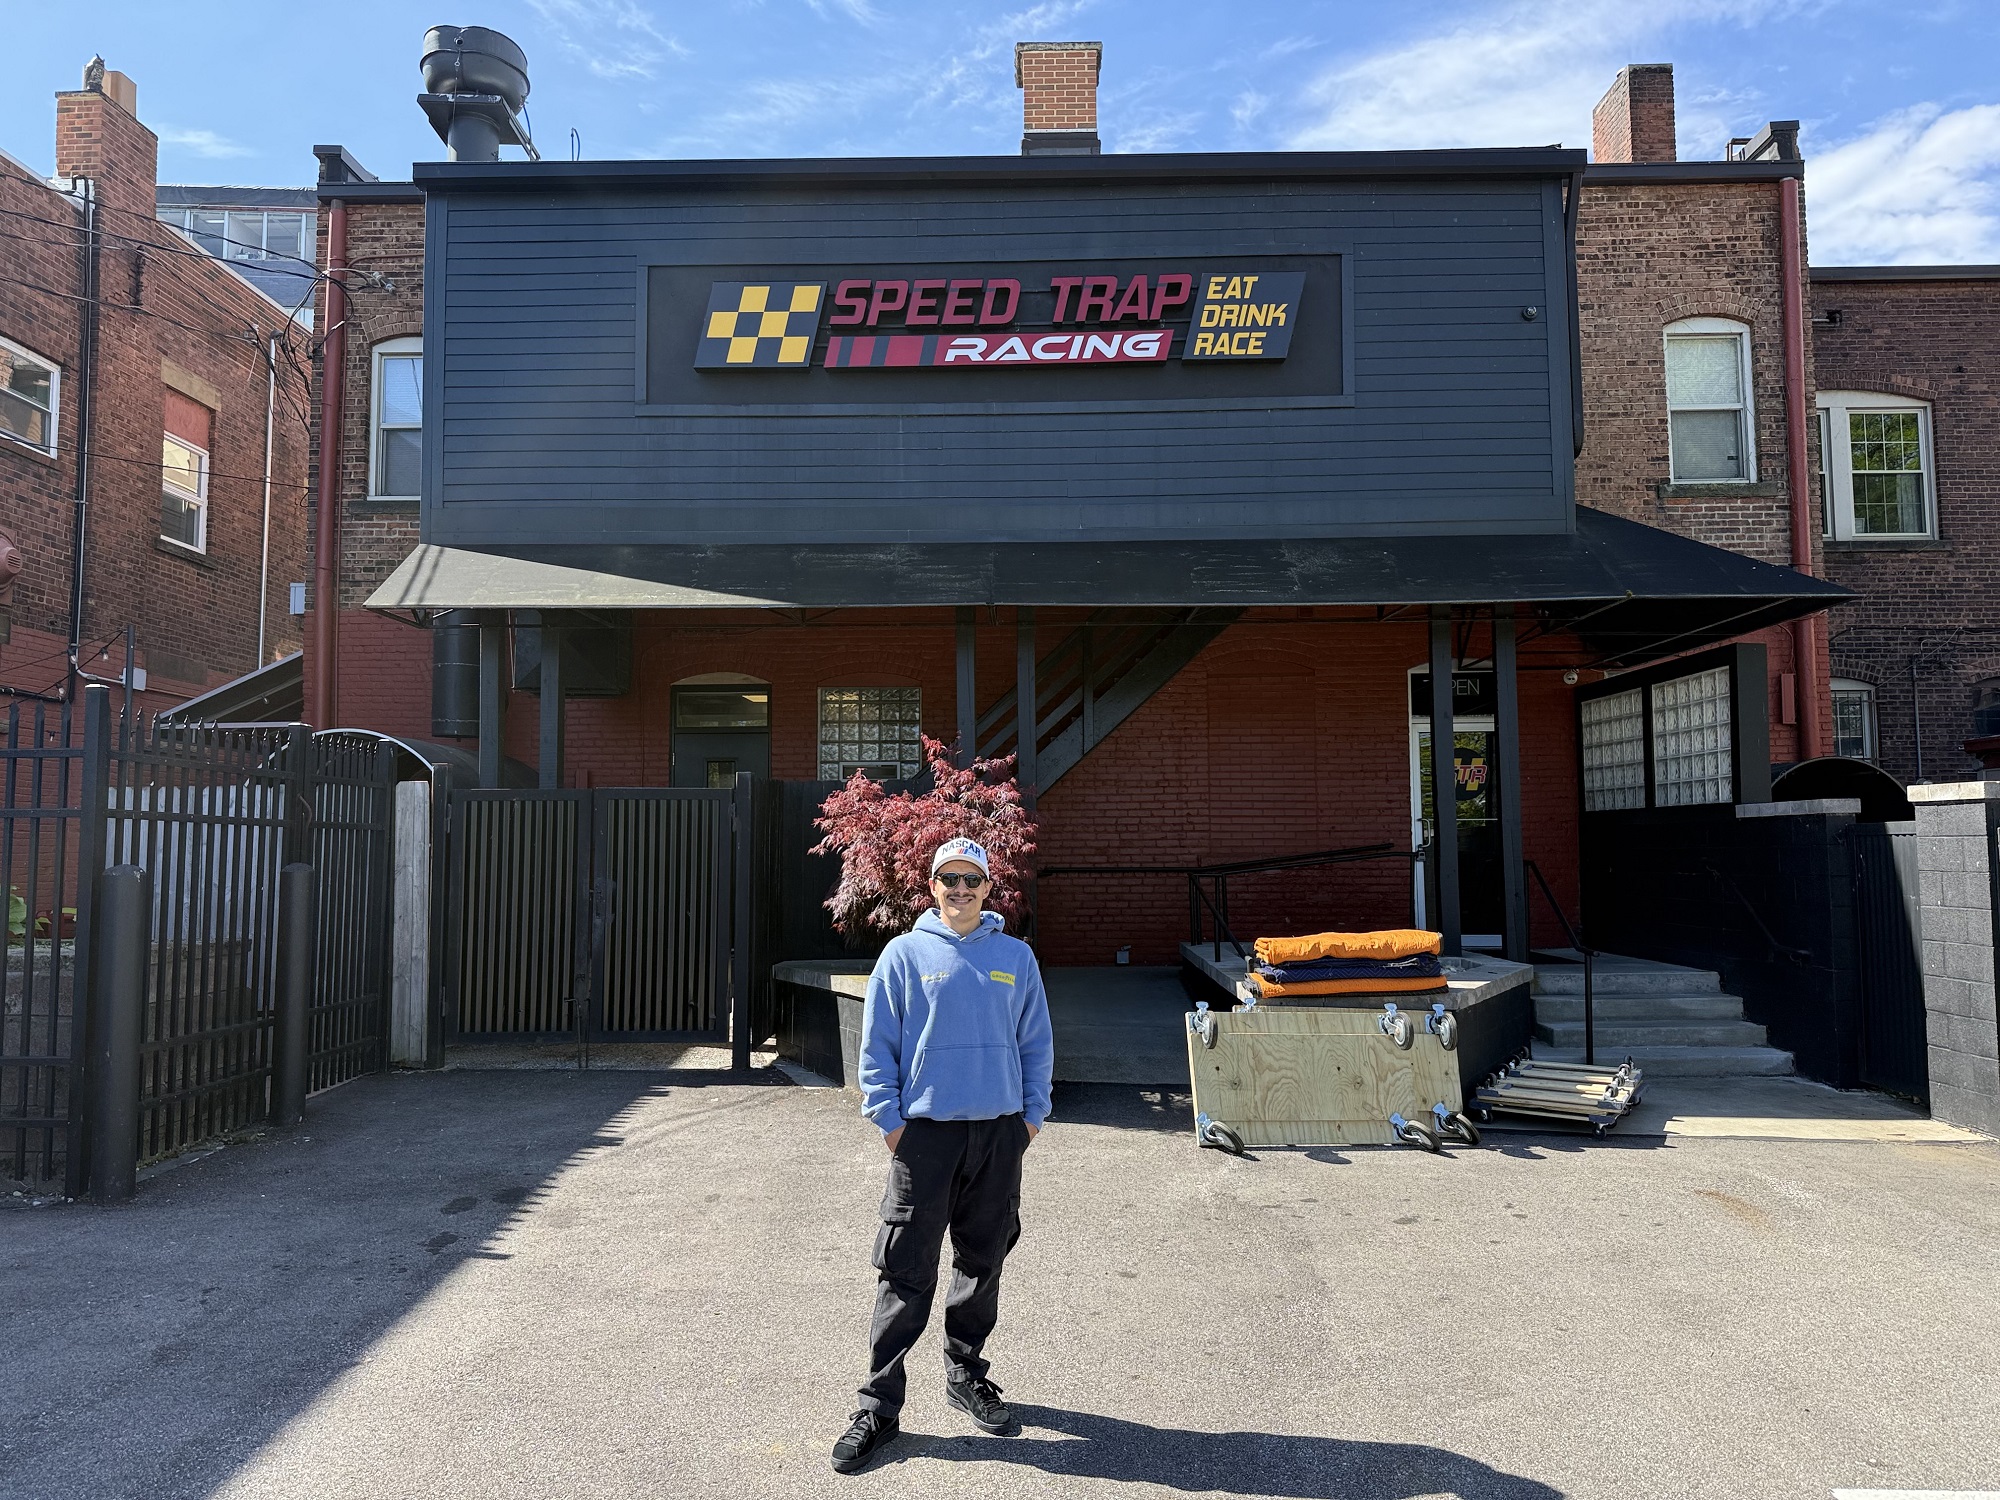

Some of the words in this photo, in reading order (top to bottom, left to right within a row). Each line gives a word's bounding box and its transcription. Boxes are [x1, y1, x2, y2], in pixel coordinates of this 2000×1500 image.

[829, 278, 1022, 326] SPEED
[1050, 273, 1193, 323] TRAP
[1206, 276, 1259, 300] EAT
[1199, 303, 1289, 328] DRINK
[944, 333, 1165, 362] RACING
[1193, 332, 1267, 356] RACE
[1452, 678, 1480, 695] EN
[941, 840, 981, 858] NASCAR
